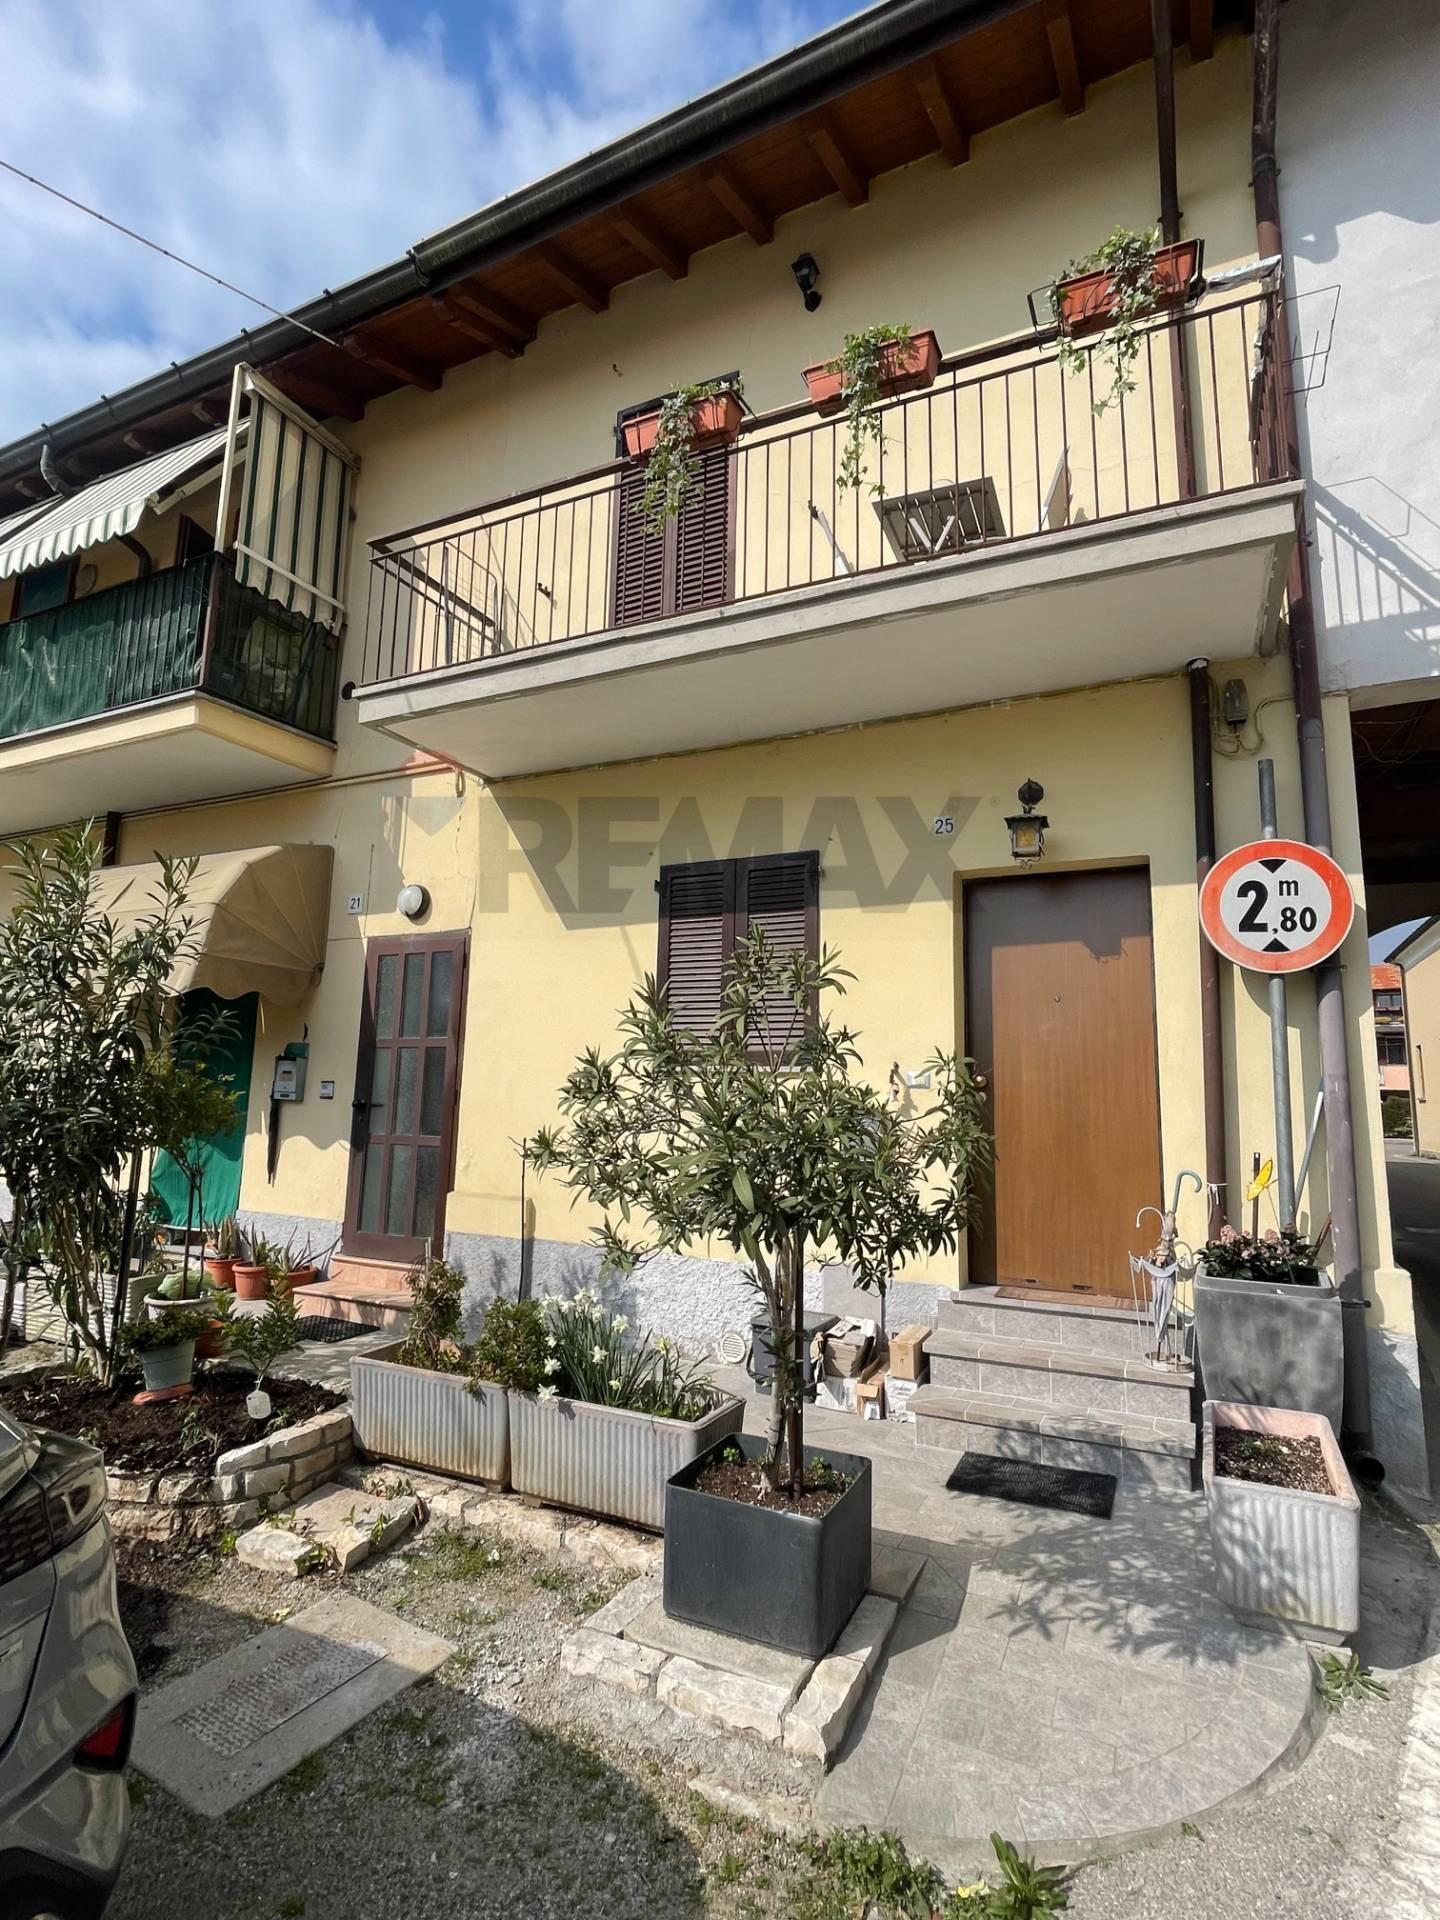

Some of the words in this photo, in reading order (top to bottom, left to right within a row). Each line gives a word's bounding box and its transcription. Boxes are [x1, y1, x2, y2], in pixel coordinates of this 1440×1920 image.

[934, 817, 954, 835] 25
[1278, 879, 1299, 897] m
[350, 896, 361, 910] 21
